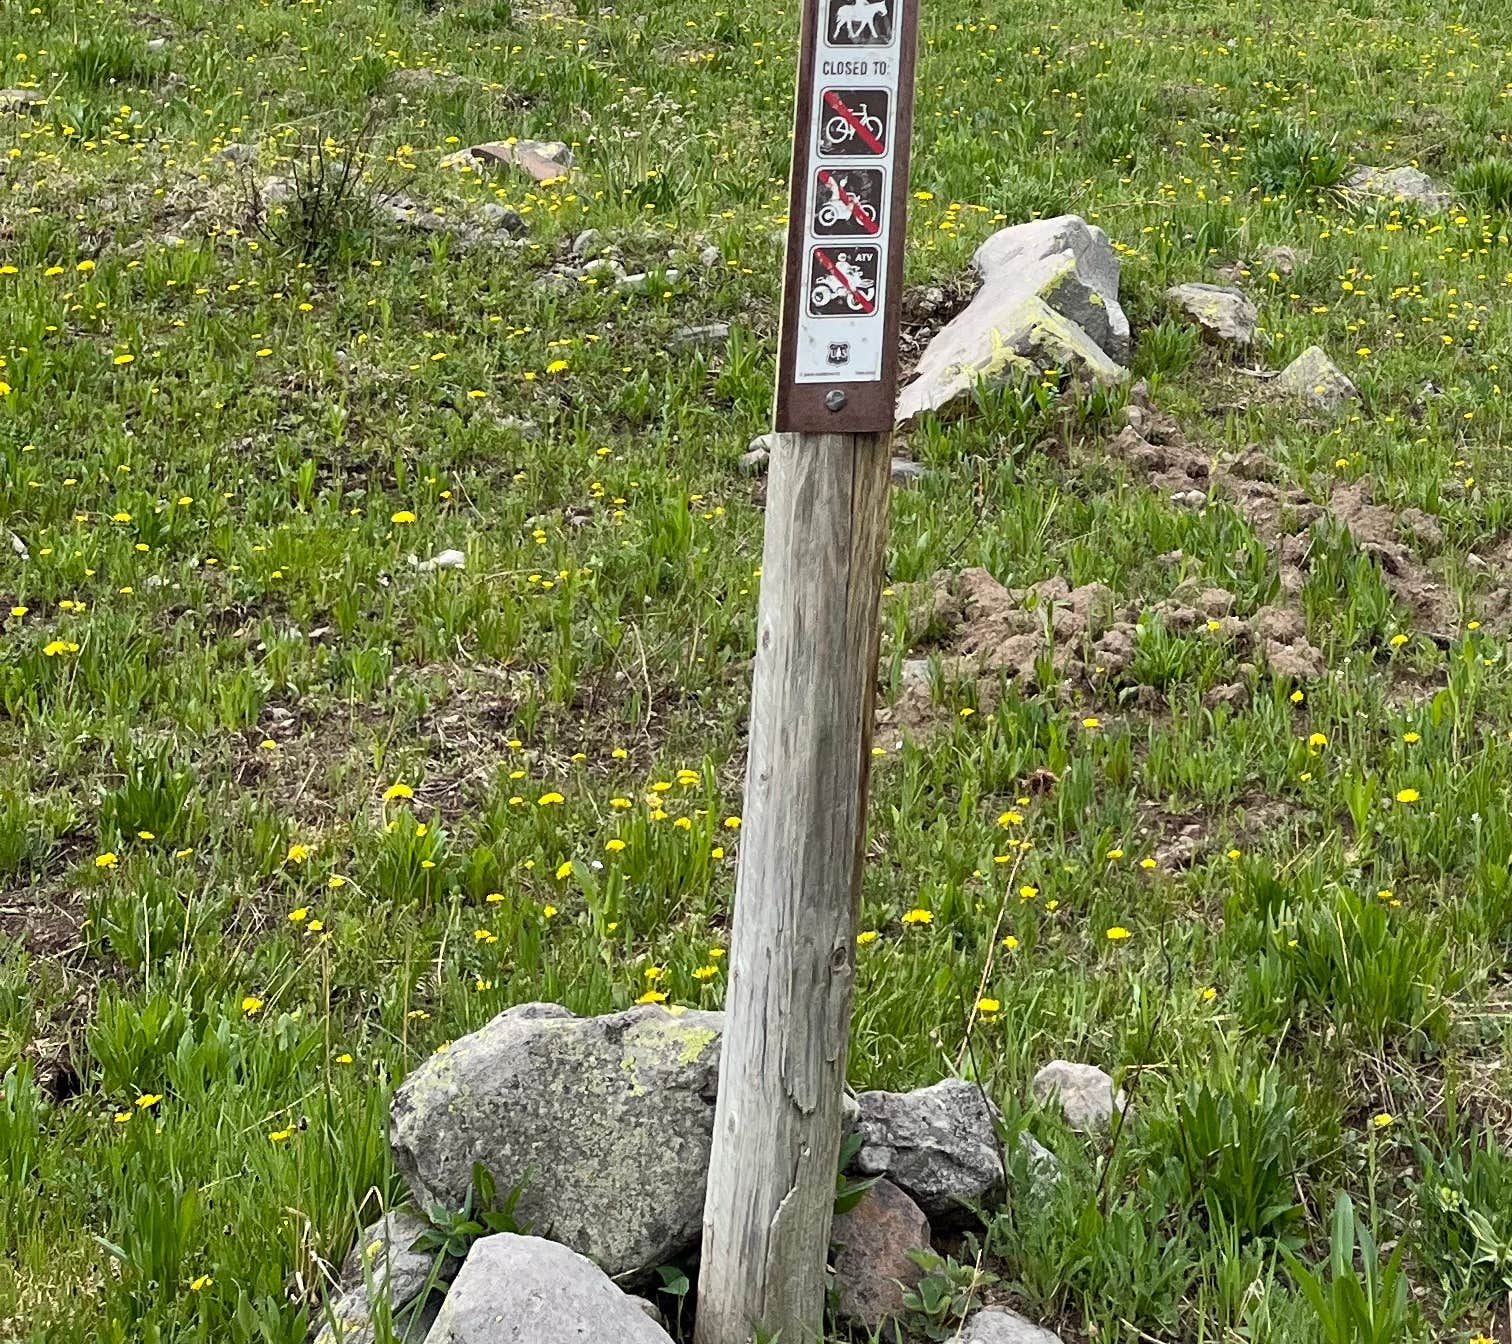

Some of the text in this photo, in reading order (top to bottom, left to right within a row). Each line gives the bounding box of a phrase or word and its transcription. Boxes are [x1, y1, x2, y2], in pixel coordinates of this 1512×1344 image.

[822, 61, 891, 76] CLOSED TO:
[855, 252, 873, 262] ATV
